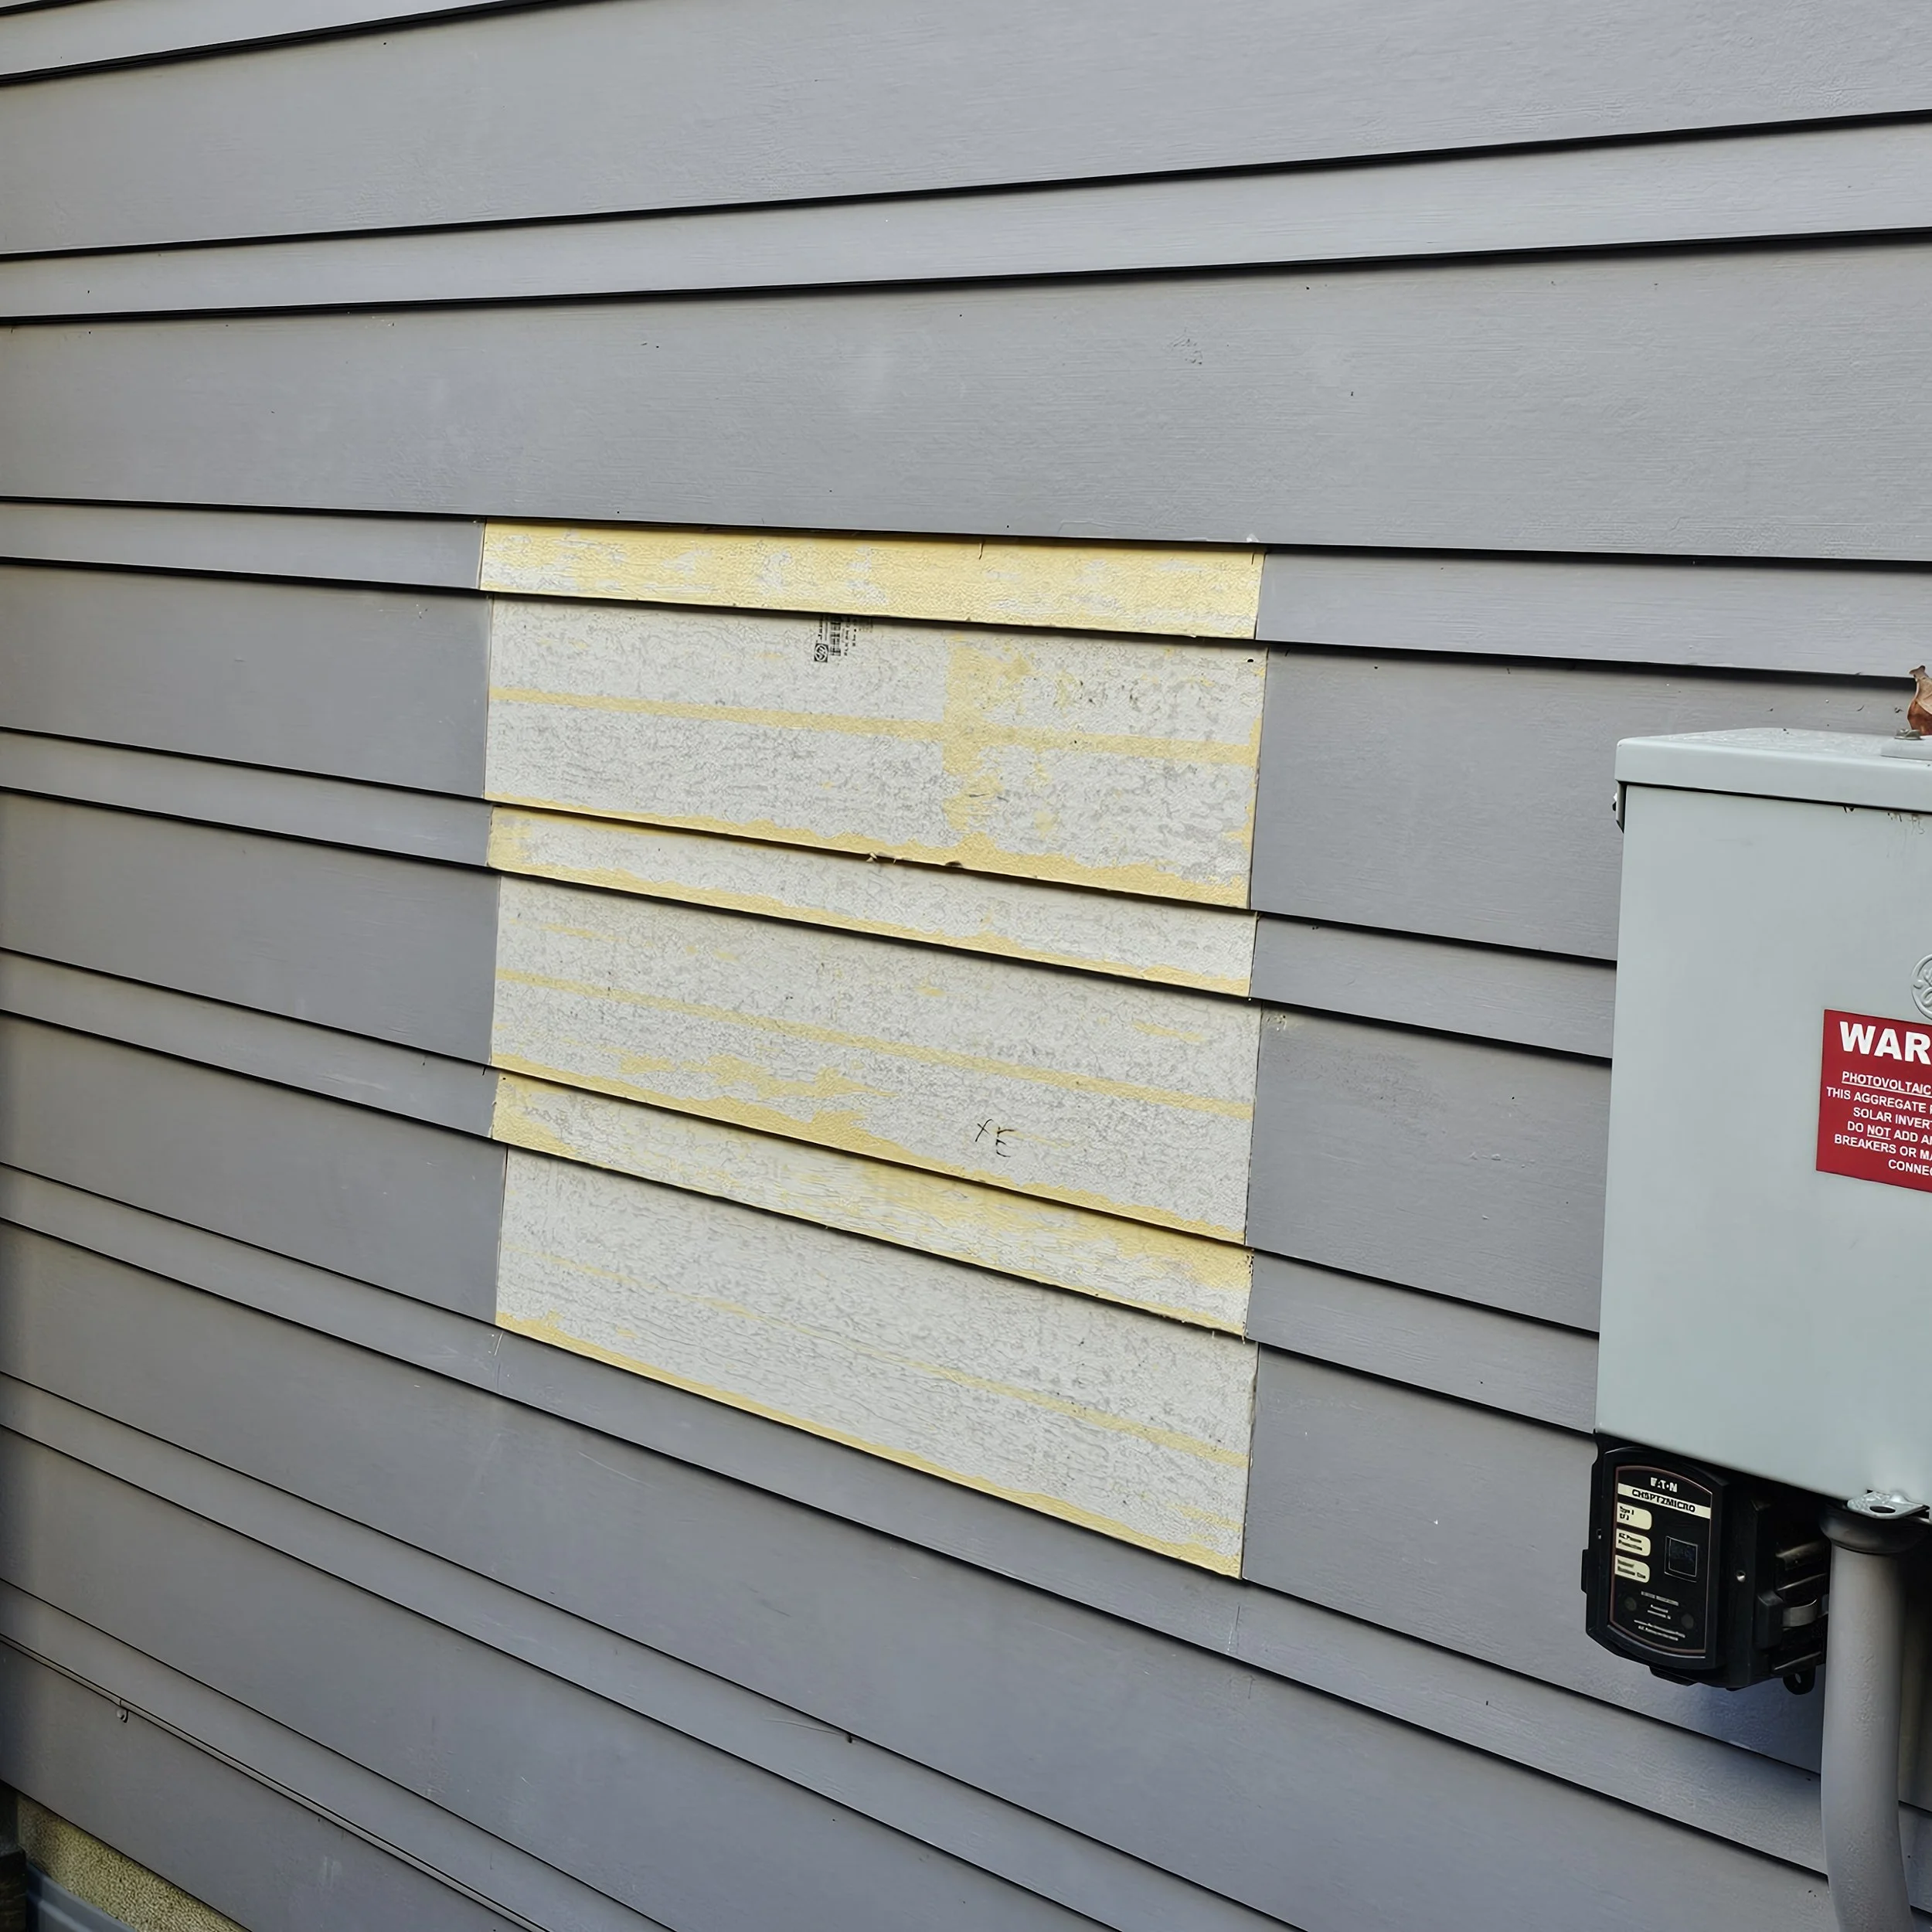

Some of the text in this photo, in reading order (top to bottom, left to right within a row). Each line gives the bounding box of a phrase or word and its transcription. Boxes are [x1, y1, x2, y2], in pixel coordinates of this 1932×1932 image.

[1839, 1021, 1931, 1065] WAR
[1842, 1071, 1931, 1097] PHOTOVOLTAIC
[1826, 1087, 1851, 1100] THIS
[1853, 1092, 1927, 1113] AGGREGATE
[1853, 1107, 1892, 1123] SOLAR
[1847, 1121, 1864, 1133] DO
[1867, 1124, 1891, 1139] NOT
[1893, 1130, 1918, 1142] ADD
[1835, 1134, 1932, 1161] BREAKERS OR M
